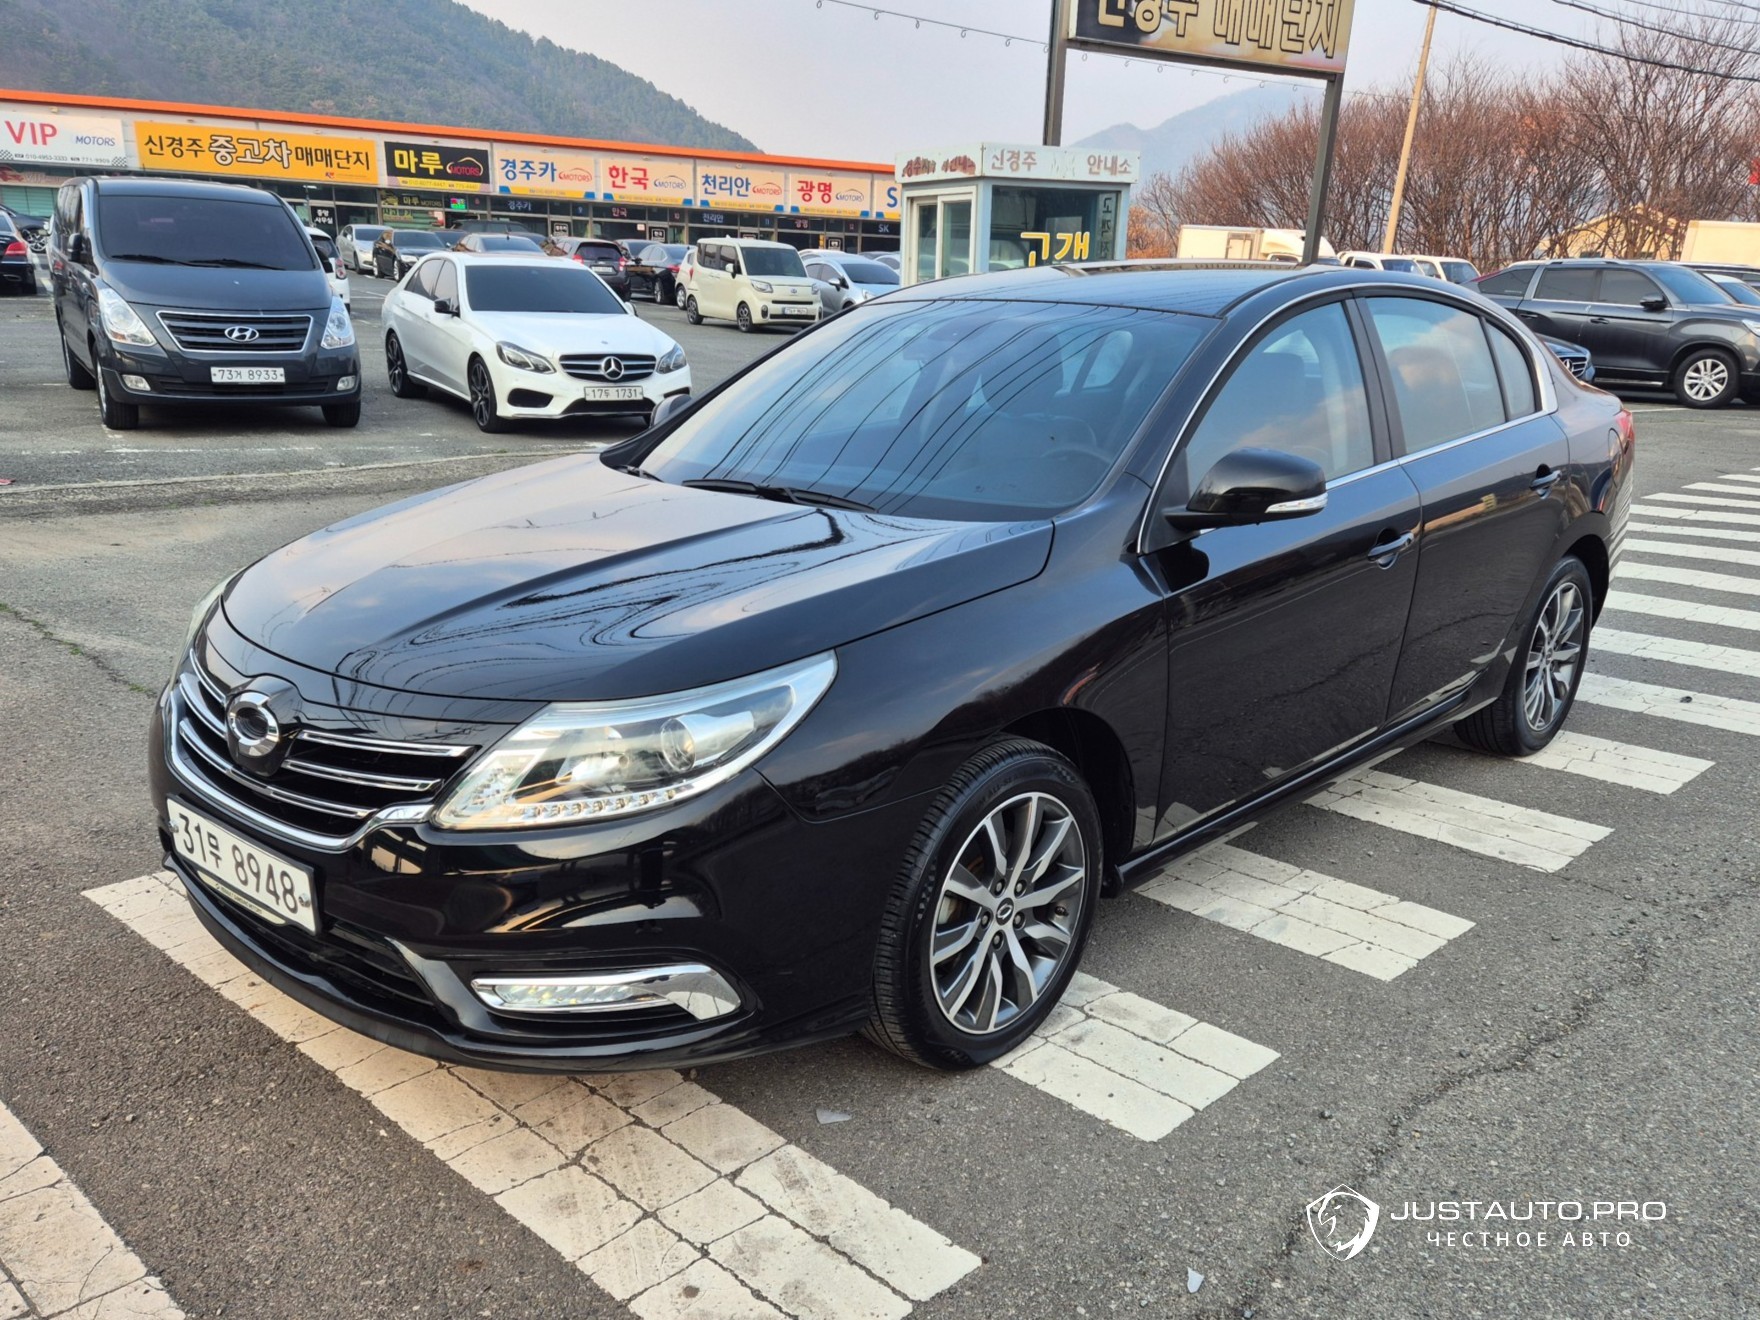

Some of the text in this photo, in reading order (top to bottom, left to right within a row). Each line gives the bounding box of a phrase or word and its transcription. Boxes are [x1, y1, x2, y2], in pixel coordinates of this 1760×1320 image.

[5, 120, 57, 146] VIP
[75, 135, 116, 147] MOTORS
[144, 134, 370, 171] 신경주 중고차 매매단지
[394, 149, 444, 176] 마루
[991, 148, 1037, 172] 신경주
[1086, 154, 1131, 176] 안내소
[450, 166, 480, 176] MOTORS
[500, 158, 557, 182] 경주카
[563, 173, 590, 182] MOTORS
[608, 165, 649, 190] 한국
[657, 181, 685, 190] MOTORS
[701, 173, 751, 197] 천리안
[756, 187, 781, 196] MOTORS
[797, 180, 833, 204] 광명
[840, 194, 863, 202] MOTORS
[507, 200, 532, 211] 경주카
[702, 212, 724, 223] 천리안
[878, 223, 890, 233] SK
[247, 369, 278, 381] 8933
[615, 388, 637, 399] 1731
[231, 844, 298, 914] 8948
